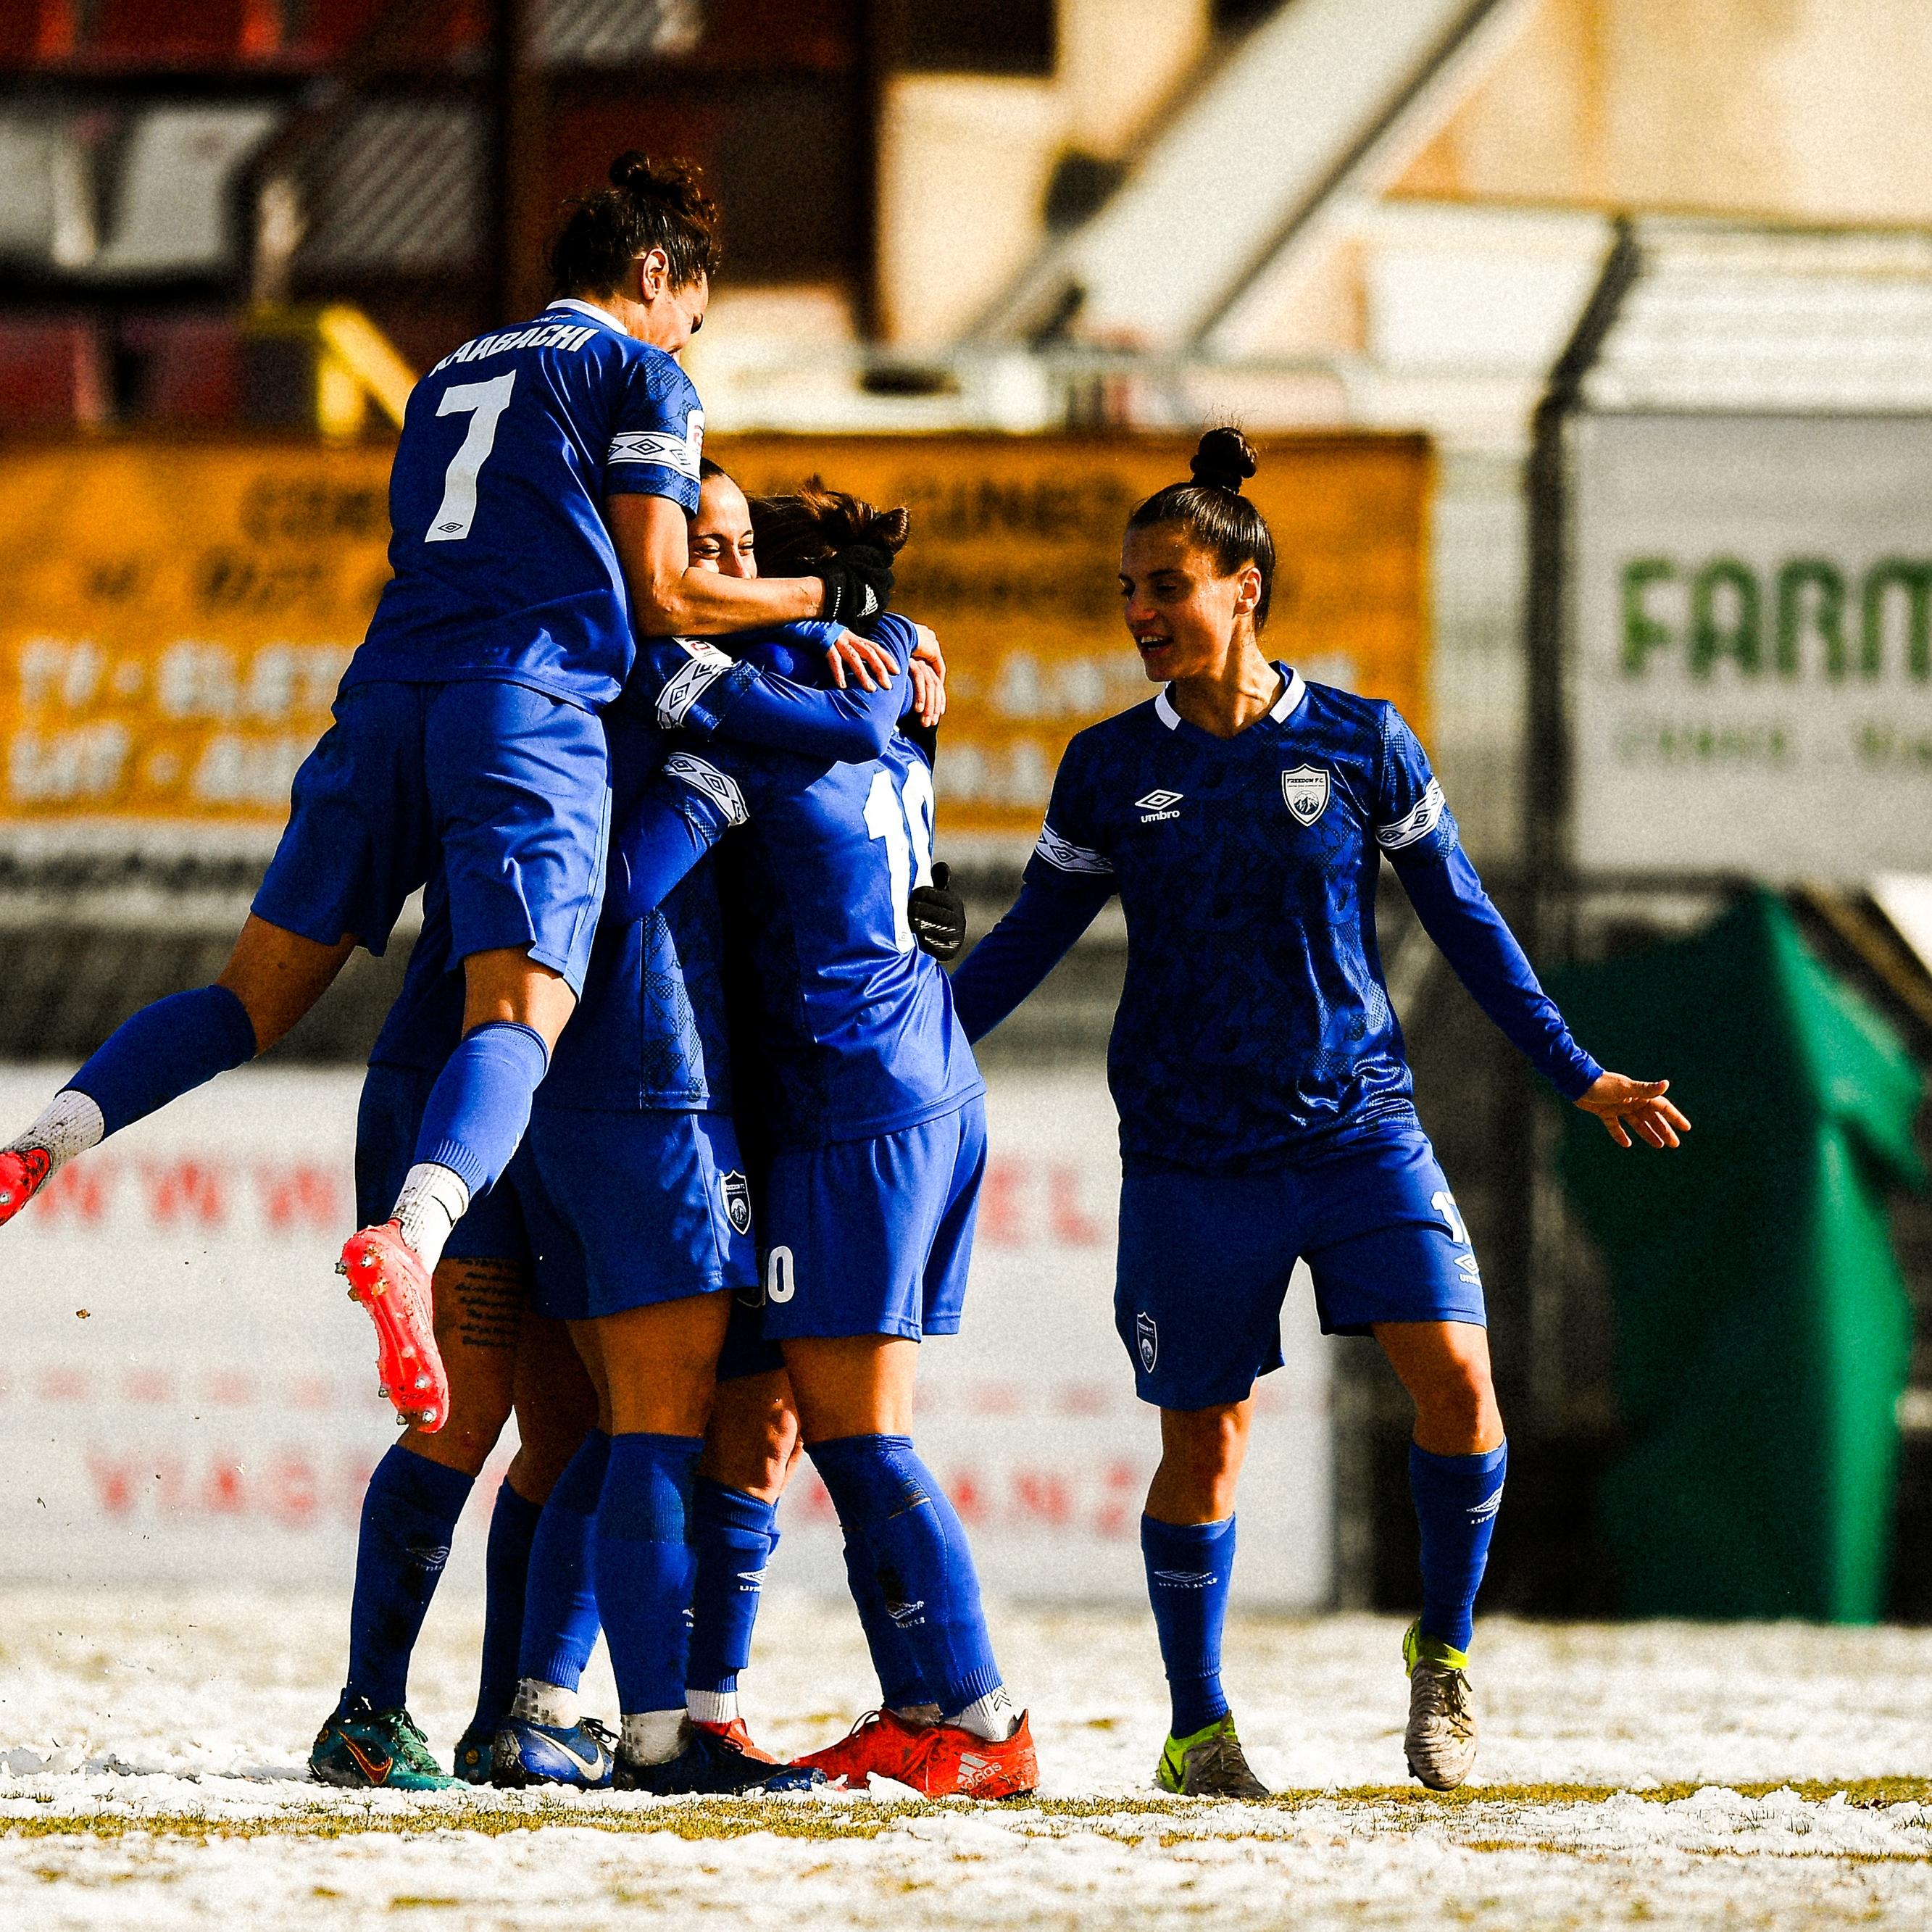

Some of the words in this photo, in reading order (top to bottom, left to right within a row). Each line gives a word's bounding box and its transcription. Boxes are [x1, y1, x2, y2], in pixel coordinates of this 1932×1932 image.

[425, 370, 516, 543] 7
[862, 759, 935, 954] 10
[1141, 810, 1181, 823] umbro
